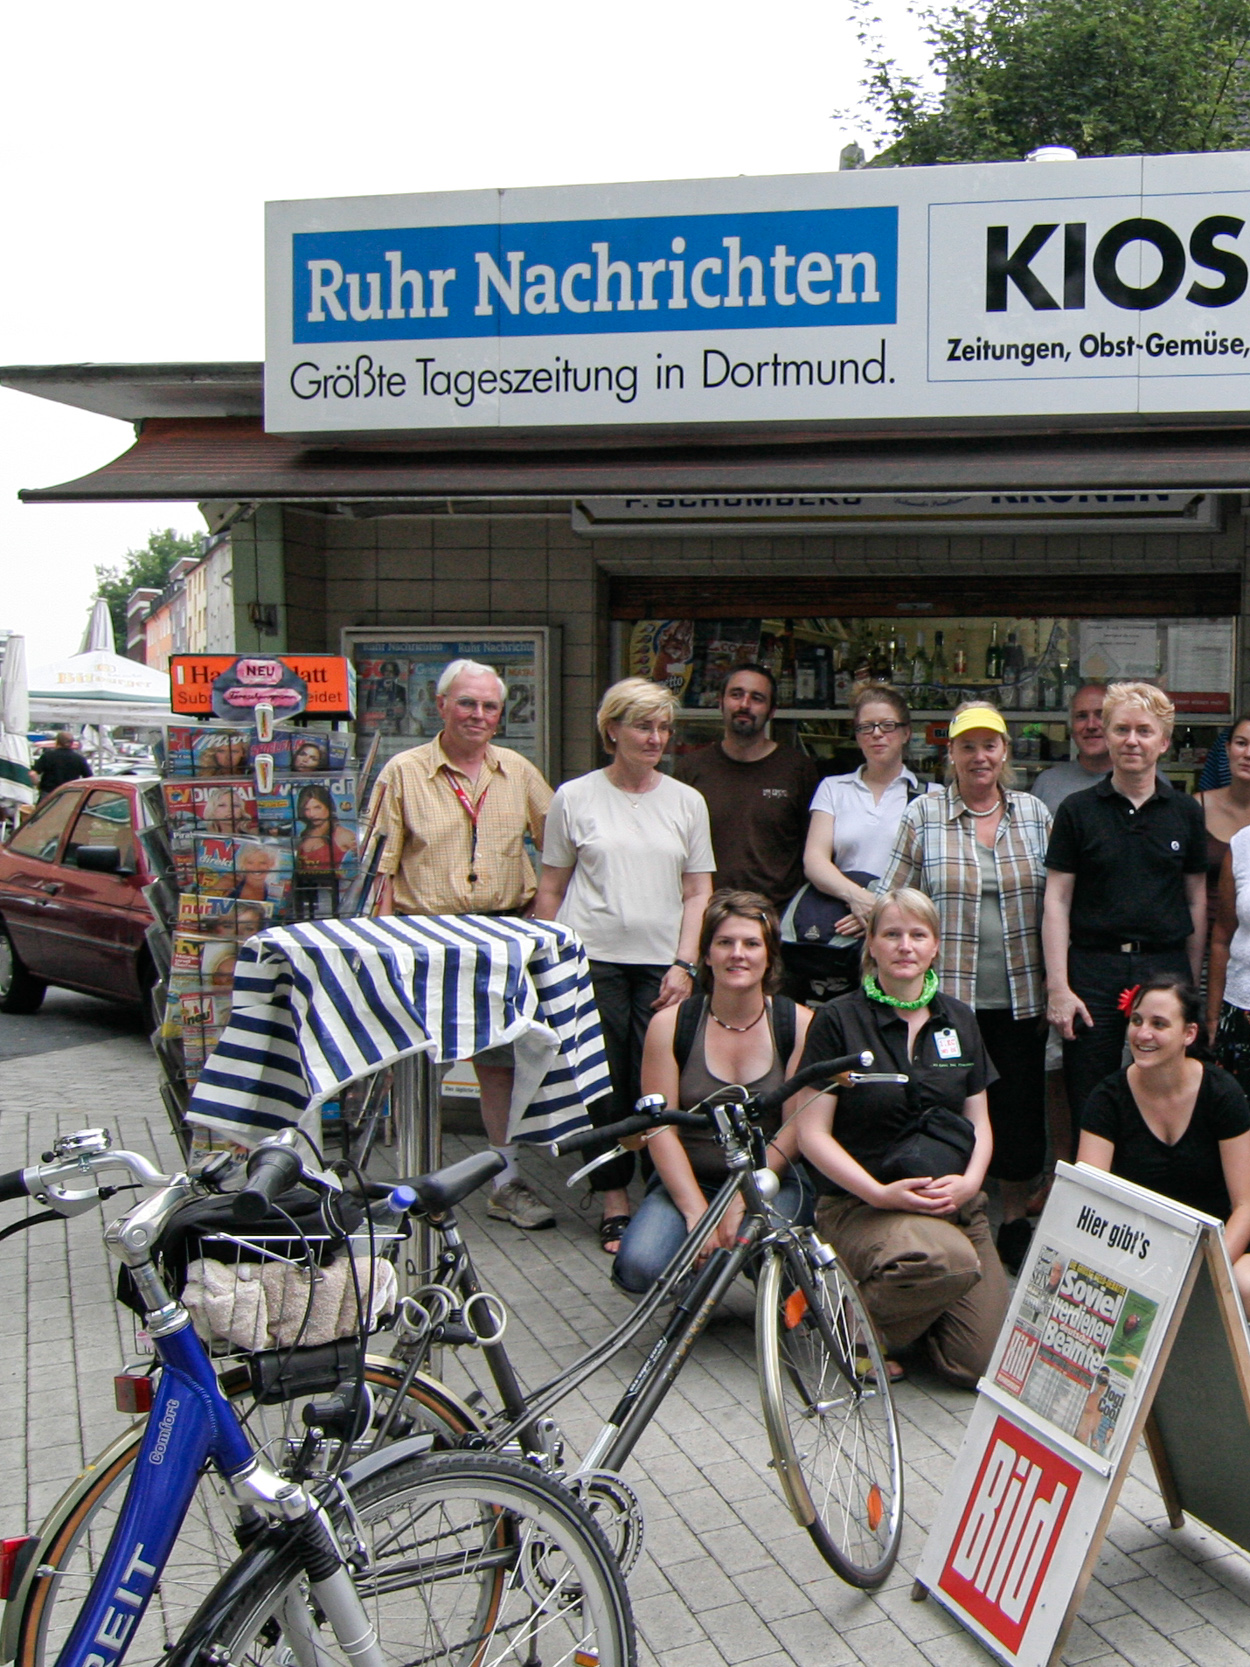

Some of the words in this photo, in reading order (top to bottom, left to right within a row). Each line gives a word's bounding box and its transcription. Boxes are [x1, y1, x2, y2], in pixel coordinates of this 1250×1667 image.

[307, 251, 456, 323] Ruhr
[474, 236, 881, 316] Nachrichten
[290, 355, 407, 401] Größte
[415, 356, 638, 408] Tageszeitung
[656, 353, 685, 391] in
[703, 339, 896, 390] Dortmund.
[947, 336, 1072, 367] Zeitungen,
[1079, 329, 1250, 359] Obst-Gemüse,
[245, 665, 276, 677] NEU
[199, 854, 234, 868] direkt
[201, 838, 241, 861] TV
[1076, 1204, 1109, 1240] Hier
[1106, 1221, 1151, 1260] gibt's
[1060, 1269, 1126, 1321] Soviel
[1002, 1330, 1037, 1384] Bild
[1041, 1319, 1103, 1375] Beamte
[149, 1398, 180, 1466] Comfort
[951, 1438, 1069, 1626] Bild
